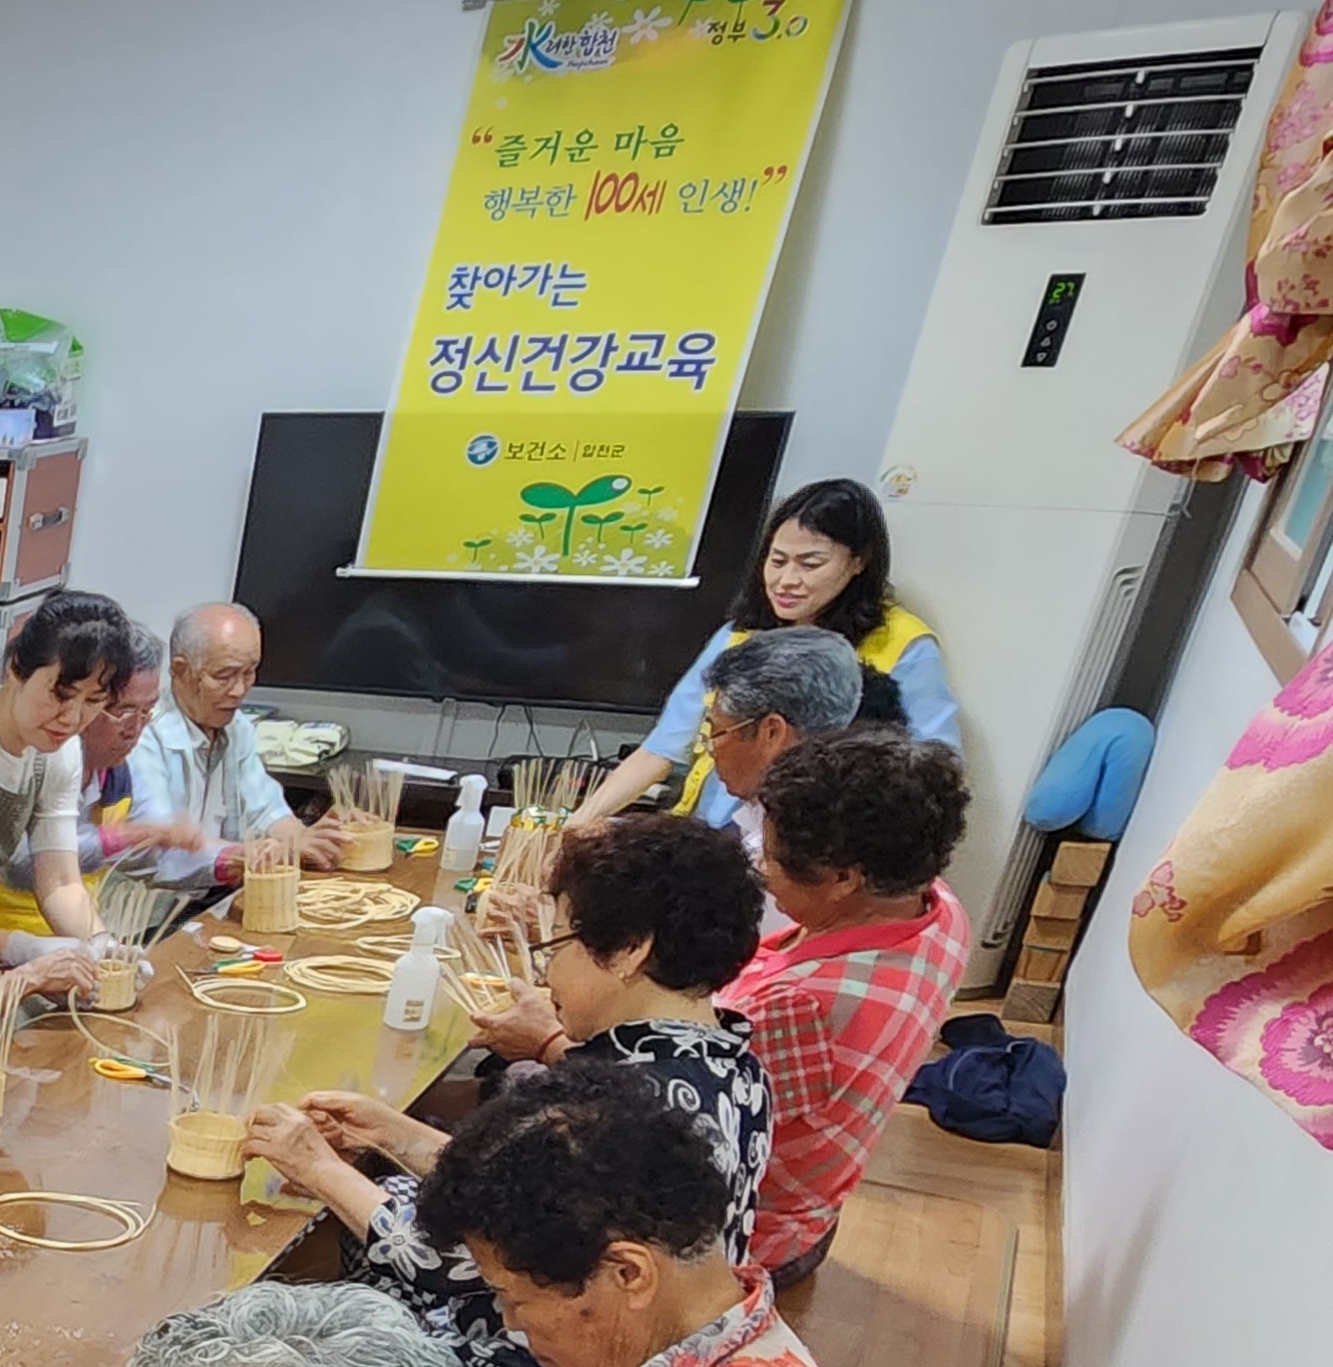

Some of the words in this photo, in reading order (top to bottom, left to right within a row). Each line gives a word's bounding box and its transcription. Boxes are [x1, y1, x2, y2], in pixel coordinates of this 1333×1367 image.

[707, 20, 747, 46] 정부
[614, 122, 686, 161] 마음
[484, 182, 578, 222] 행복한
[584, 169, 669, 222] 100세
[446, 263, 587, 310] 찾아가는
[429, 332, 716, 394] 정신건강교육
[504, 441, 567, 461] 보건소
